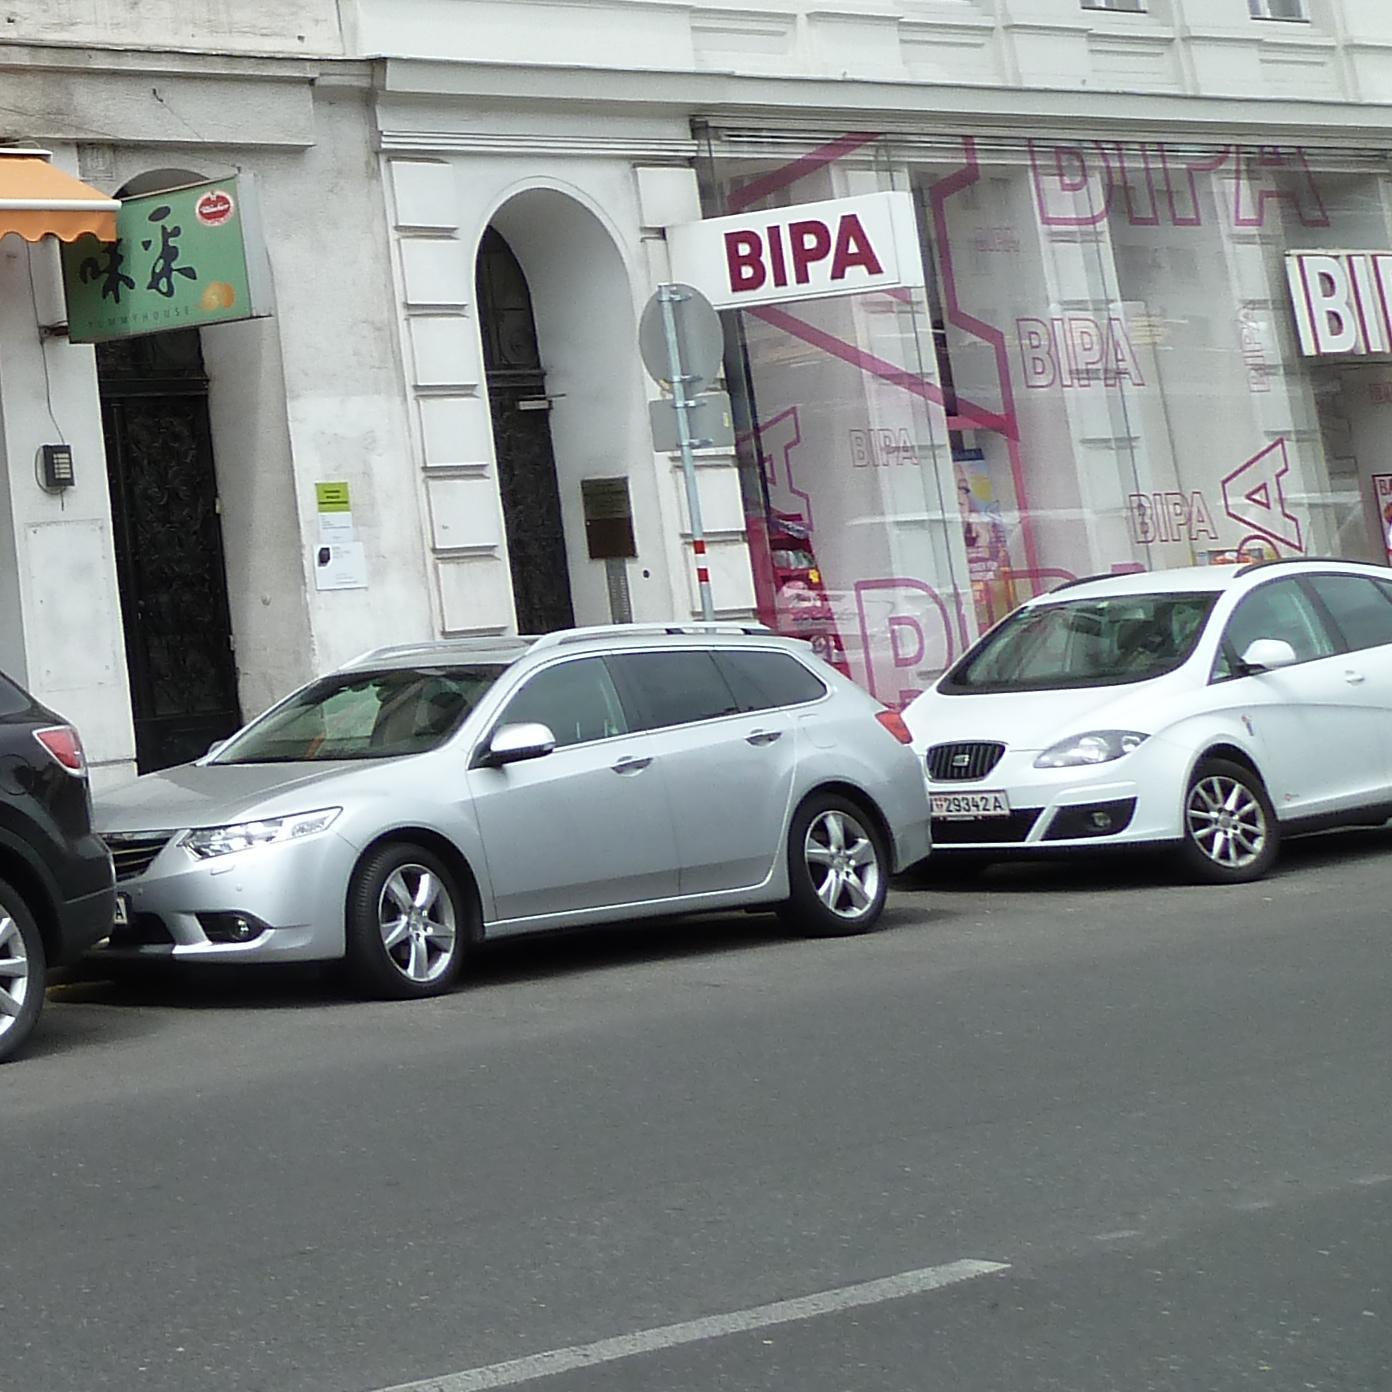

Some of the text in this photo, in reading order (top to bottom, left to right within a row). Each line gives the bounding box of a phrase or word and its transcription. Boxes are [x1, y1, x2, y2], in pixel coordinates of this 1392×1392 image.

[724, 213, 884, 293] BIPA
[1298, 254, 1392, 355] BI
[1017, 318, 1146, 389] BIPA
[849, 428, 919, 468] BIPA
[1129, 491, 1218, 544] BIPA
